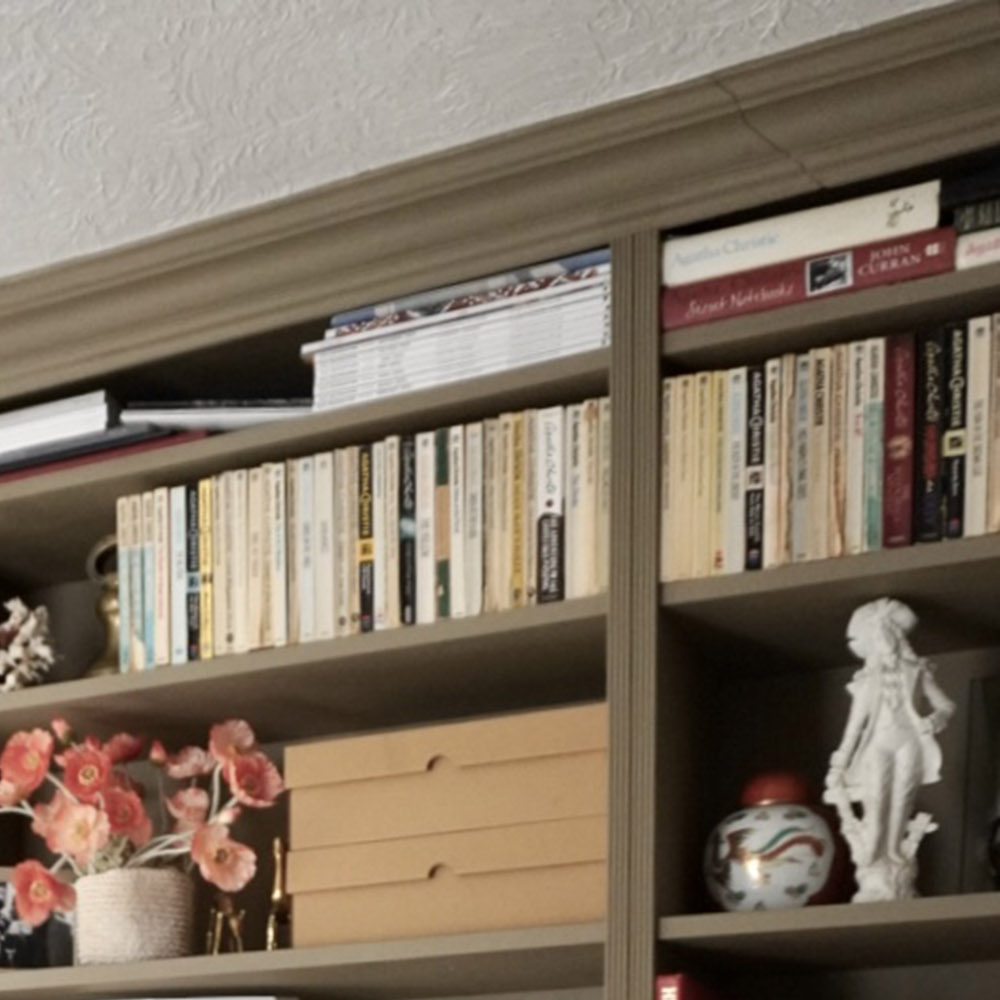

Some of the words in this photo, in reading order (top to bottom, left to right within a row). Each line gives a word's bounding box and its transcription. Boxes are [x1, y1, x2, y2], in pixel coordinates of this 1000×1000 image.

[858, 254, 921, 276] CURRAN
[870, 243, 911, 261] JOHN
[953, 330, 962, 375] AGATHA
[752, 372, 762, 416] AGATHA
[361, 453, 371, 492] AGATHA
